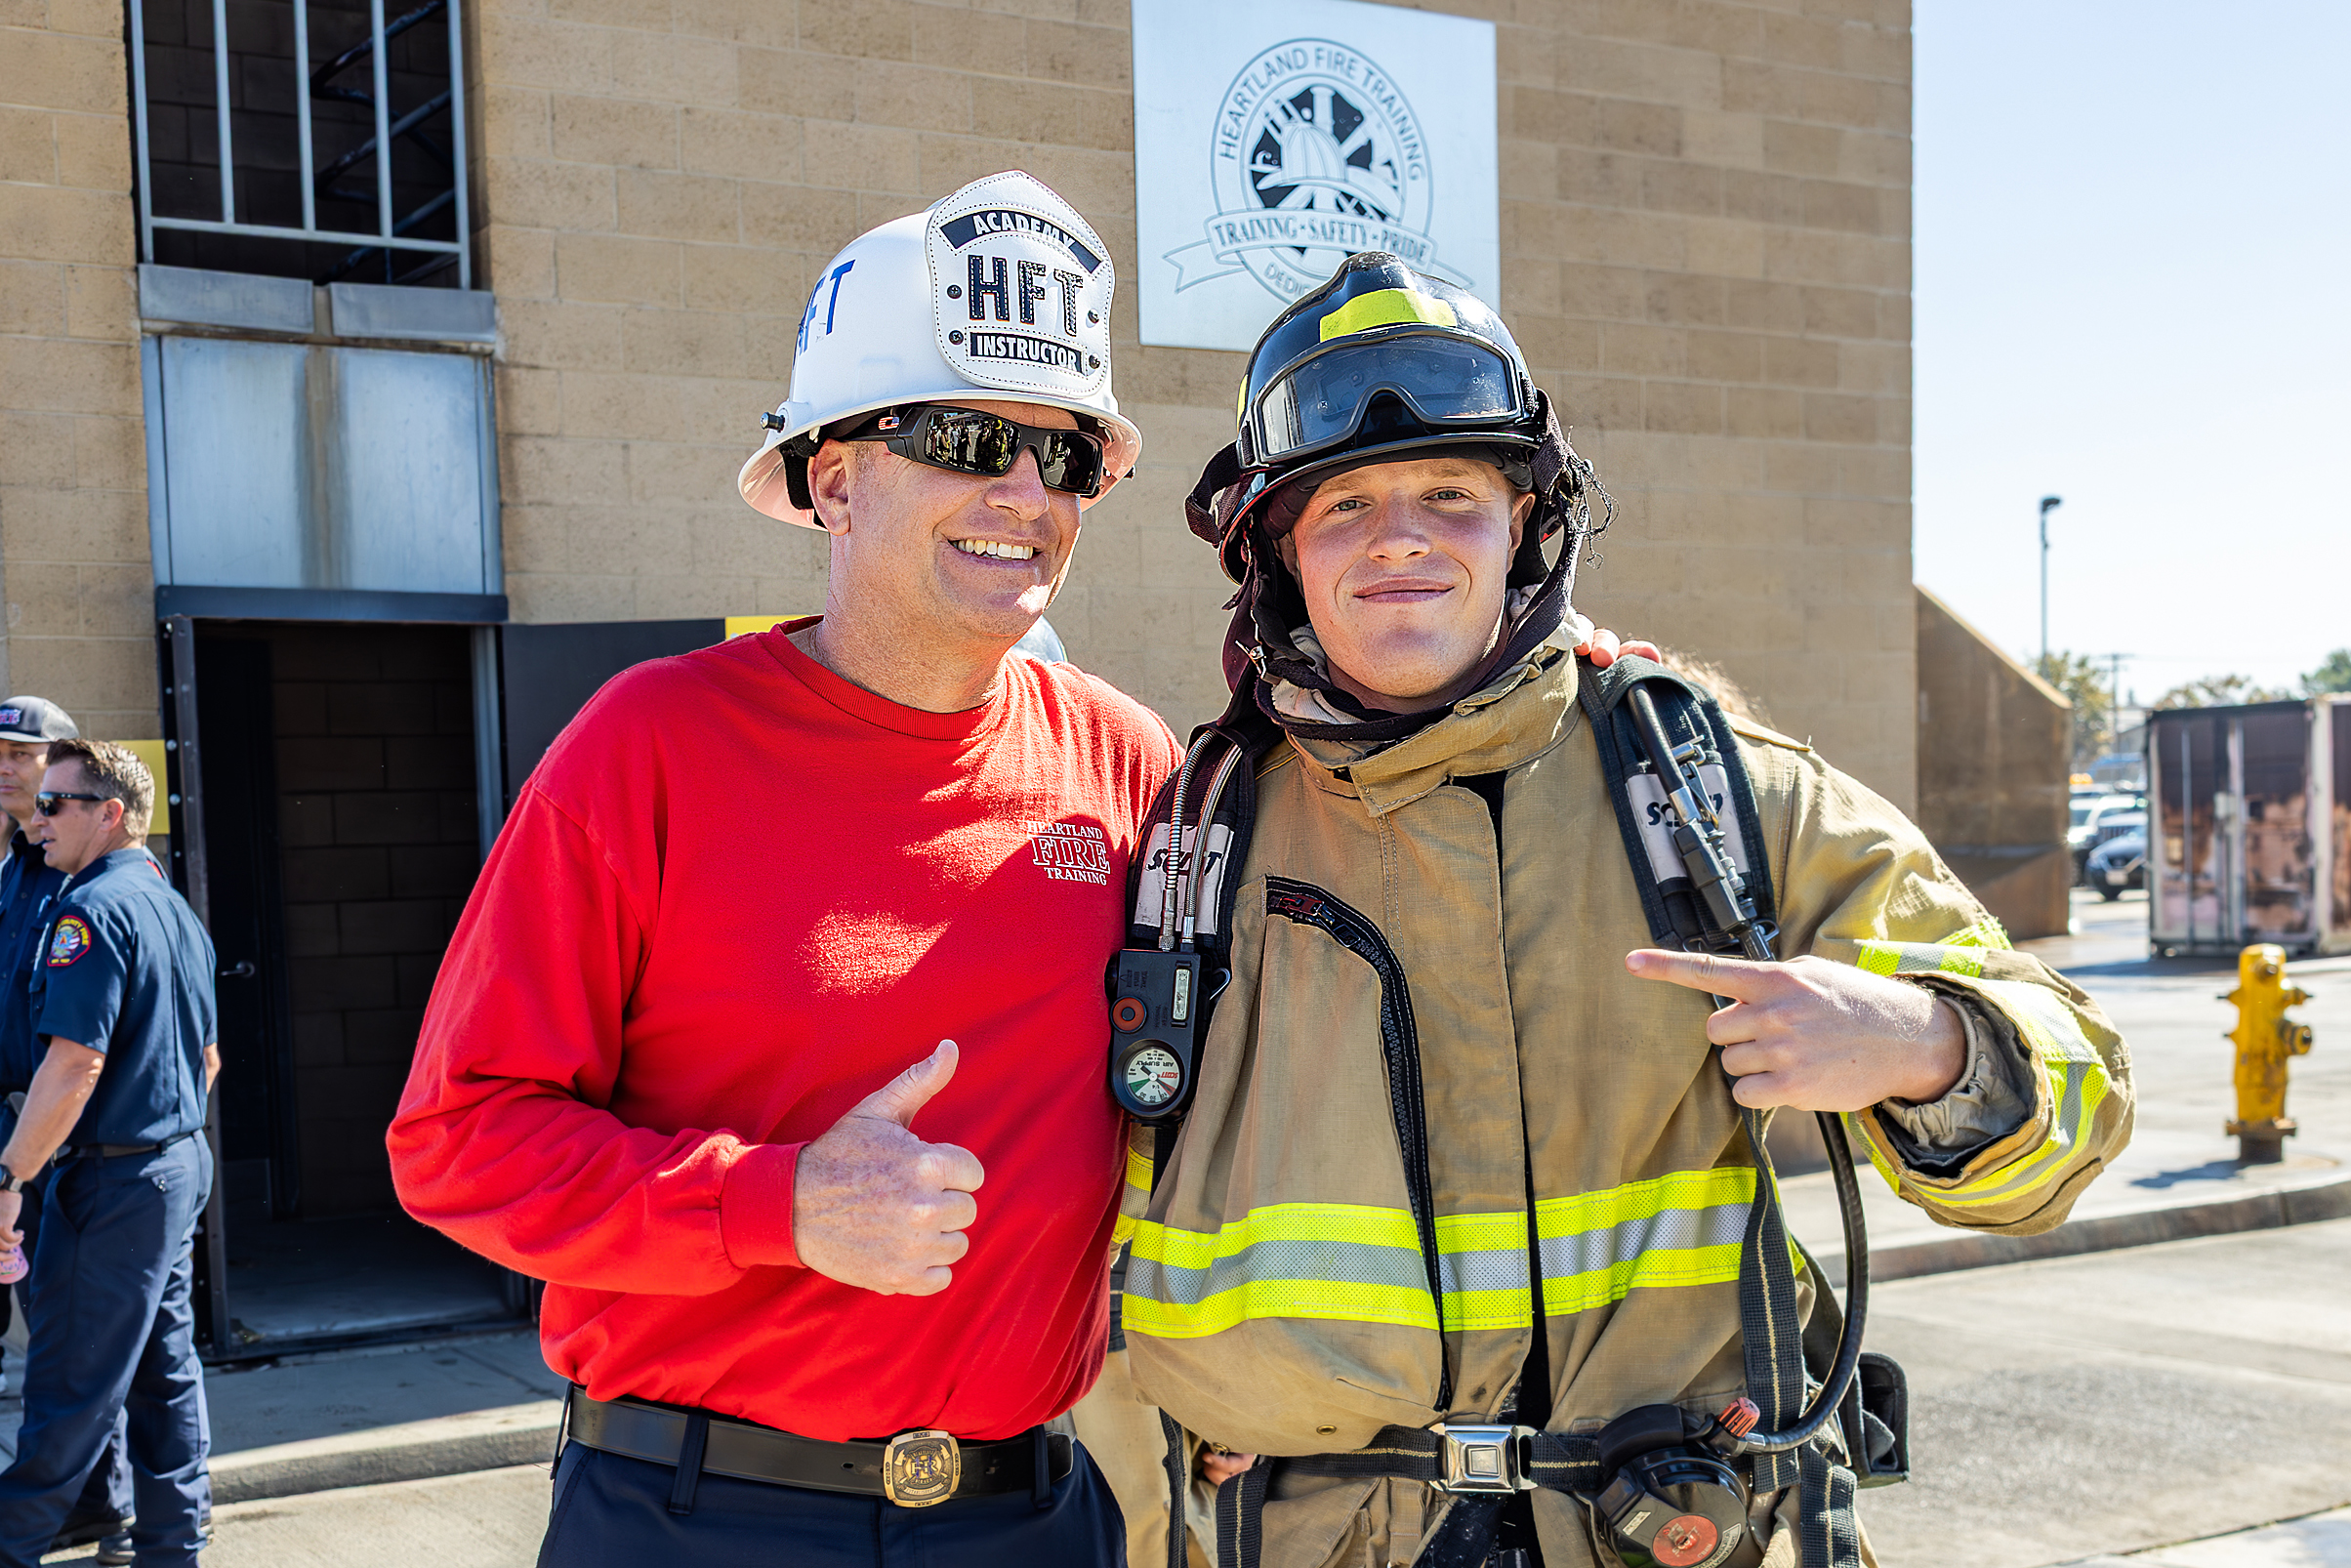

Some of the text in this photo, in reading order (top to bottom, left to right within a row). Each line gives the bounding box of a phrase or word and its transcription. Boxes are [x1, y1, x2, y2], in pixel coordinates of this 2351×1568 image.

[1219, 47, 1426, 182] HEARTLAND FIRE TRAINING
[972, 212, 1075, 250] ACADEMY
[1215, 214, 1428, 265] TRAINING SAFETY PRIDE
[792, 259, 856, 370] FT
[969, 254, 1084, 337] HFT
[976, 334, 1077, 370] INSTRUCTOR
[1024, 820, 1103, 840] HEARTLAND
[1027, 835, 1111, 875] FIRE
[1044, 866, 1107, 887] TRAINING
